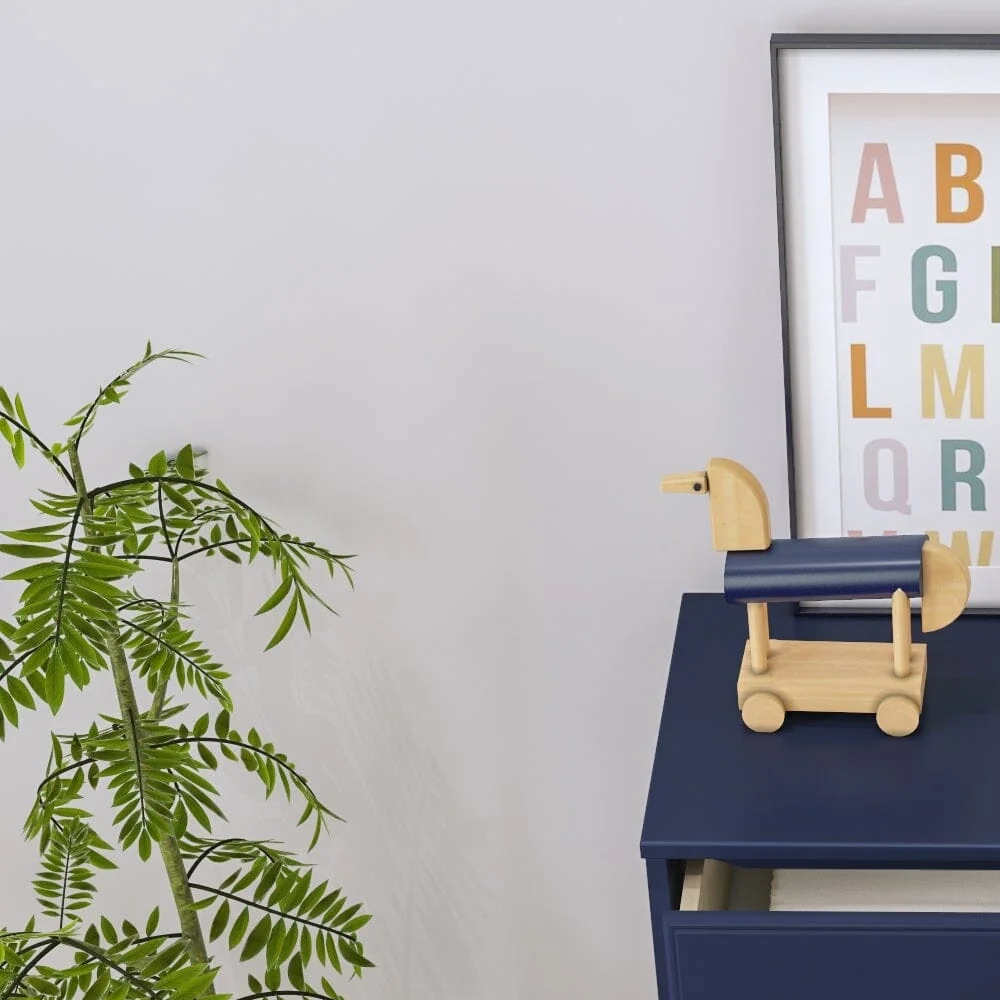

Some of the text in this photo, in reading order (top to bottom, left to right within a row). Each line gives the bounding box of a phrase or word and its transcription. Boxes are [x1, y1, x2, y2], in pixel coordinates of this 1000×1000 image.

[851, 143, 904, 224] A
[935, 142, 985, 224] B
[840, 245, 881, 323] F
[911, 244, 958, 324] G
[850, 343, 893, 419] L
[920, 344, 985, 420] M
[863, 438, 912, 515] Q
[940, 439, 987, 512] R
